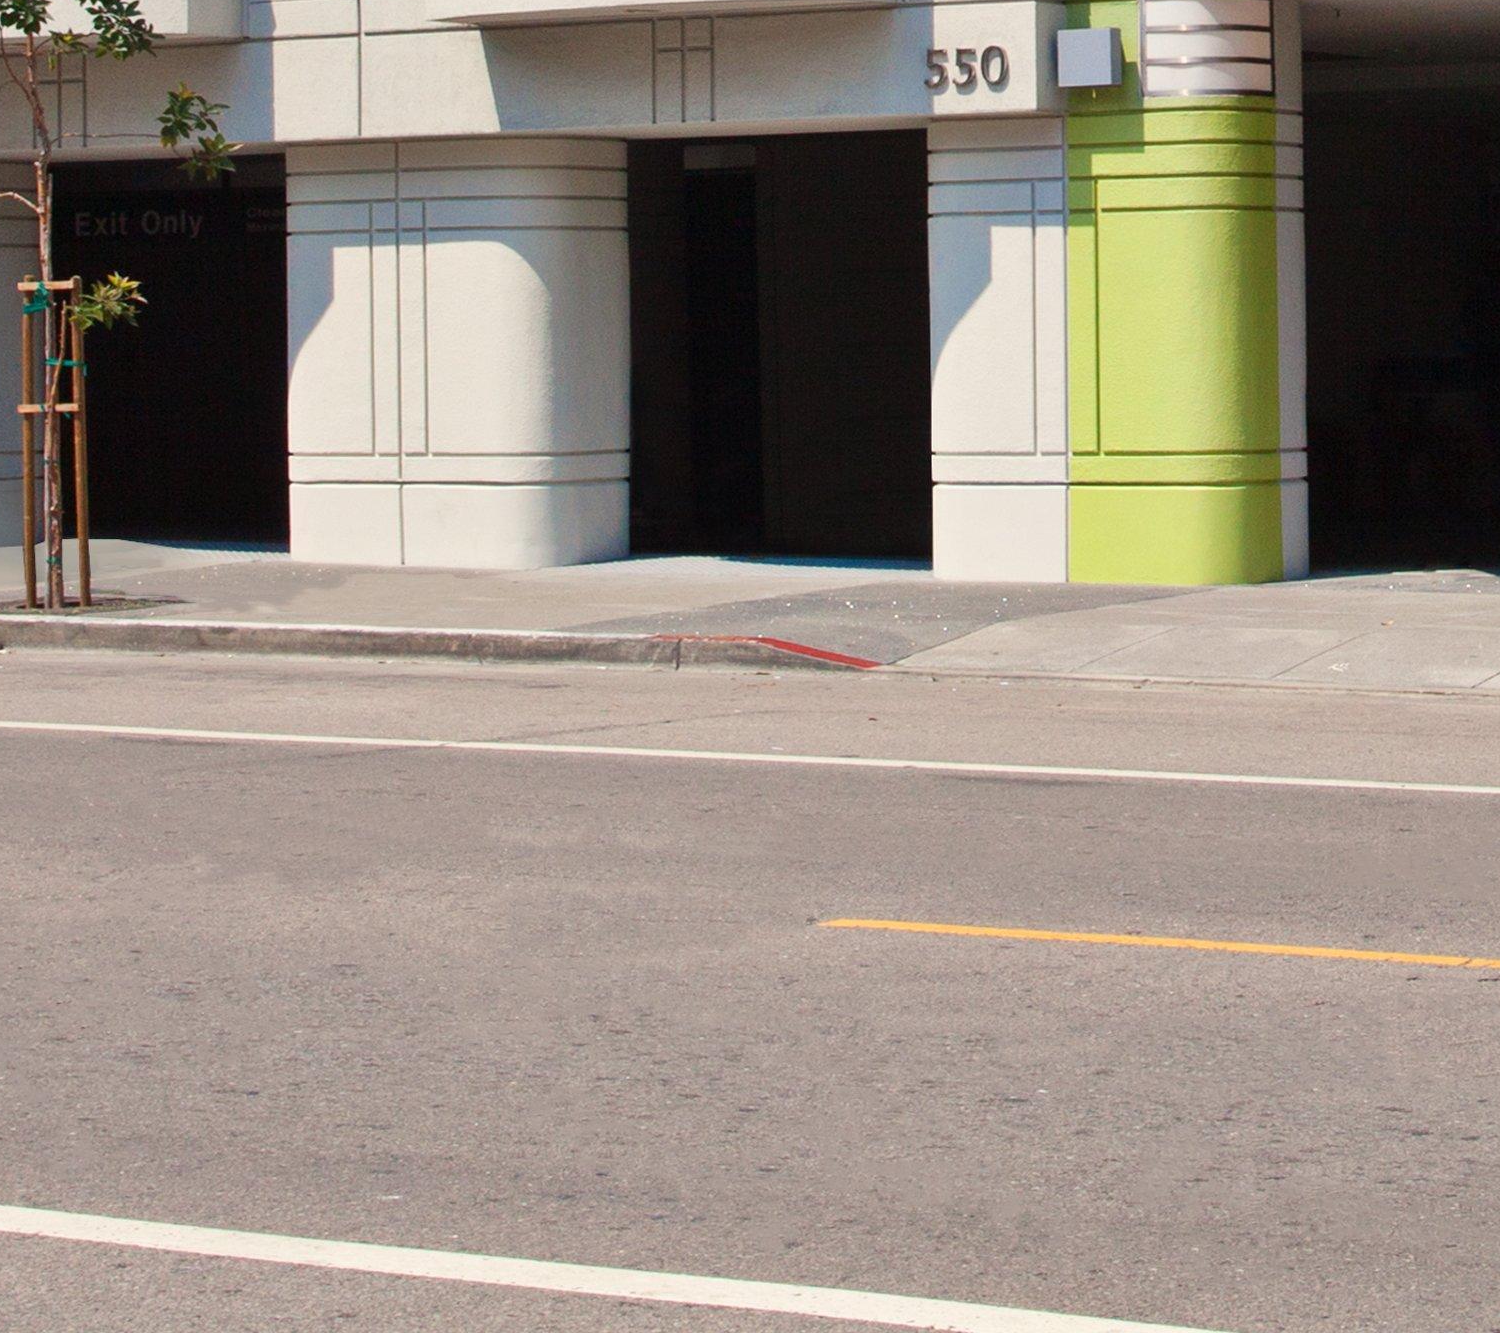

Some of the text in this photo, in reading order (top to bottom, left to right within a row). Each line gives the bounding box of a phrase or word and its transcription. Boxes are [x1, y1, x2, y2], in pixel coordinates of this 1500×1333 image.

[924, 45, 1010, 95] 550
[74, 209, 204, 238] Exit Only
